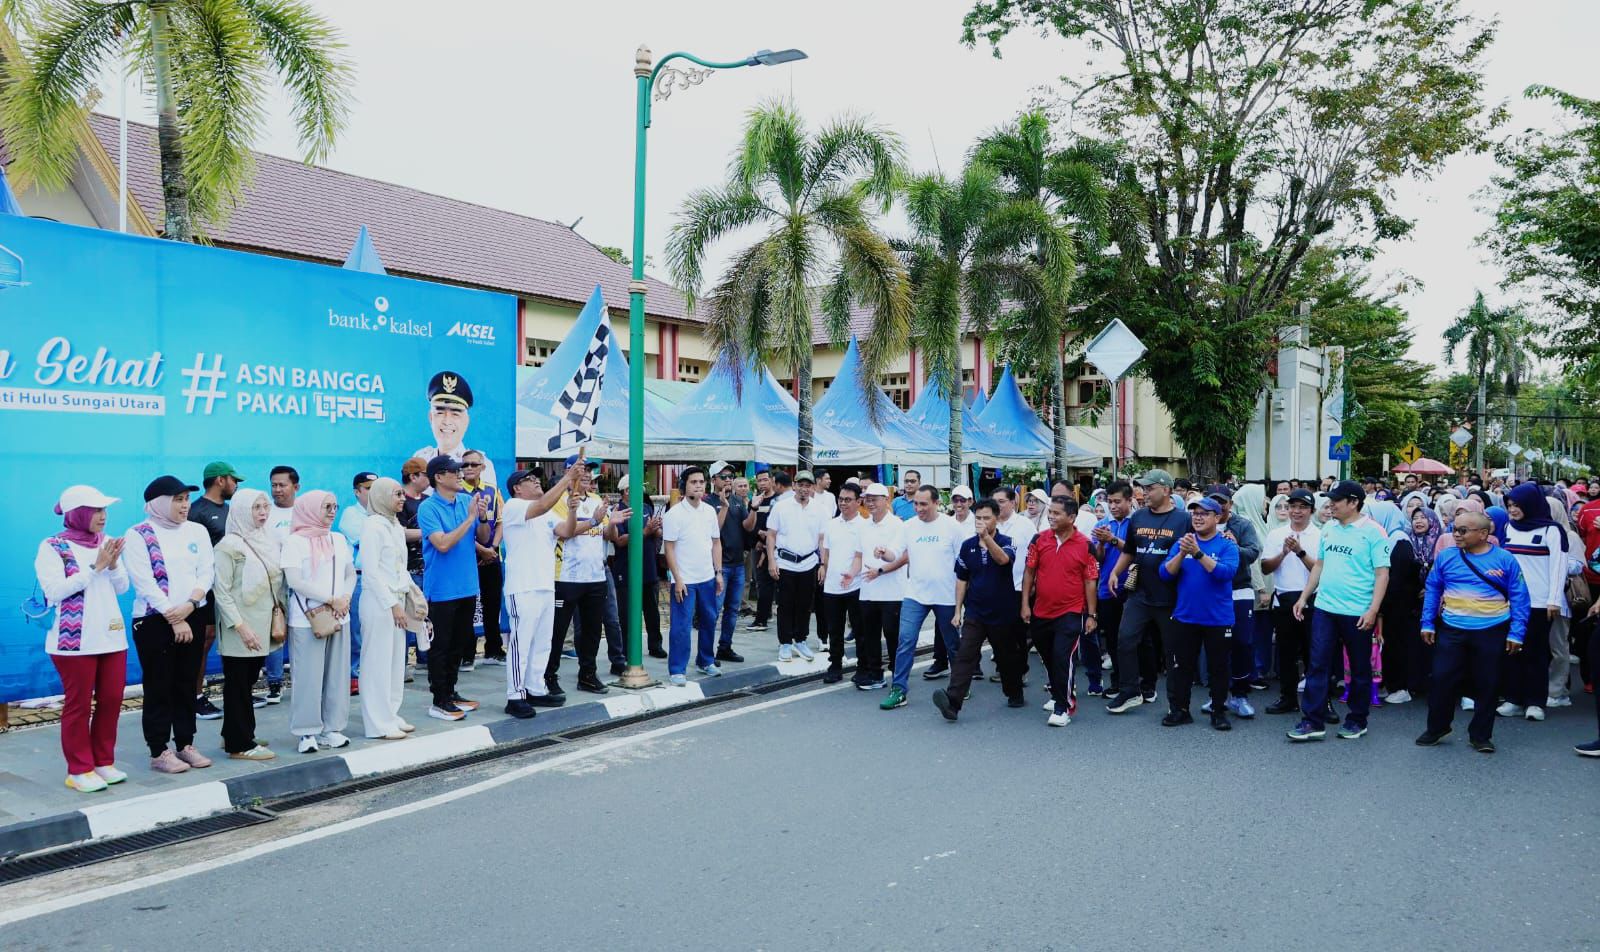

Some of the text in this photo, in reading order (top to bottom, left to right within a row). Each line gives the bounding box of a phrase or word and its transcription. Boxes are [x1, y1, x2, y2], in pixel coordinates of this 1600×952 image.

[328, 308, 433, 338] bank kalsel
[446, 321, 496, 340] AKSEL
[34, 336, 165, 388] Sehat
[236, 363, 286, 387] ASN
[291, 367, 386, 394] BANGGA
[0, 391, 160, 410] ti Hulu Sungai Utara
[236, 391, 386, 424] PAKAI QRIS
[1325, 543, 1354, 556] AKSEL
